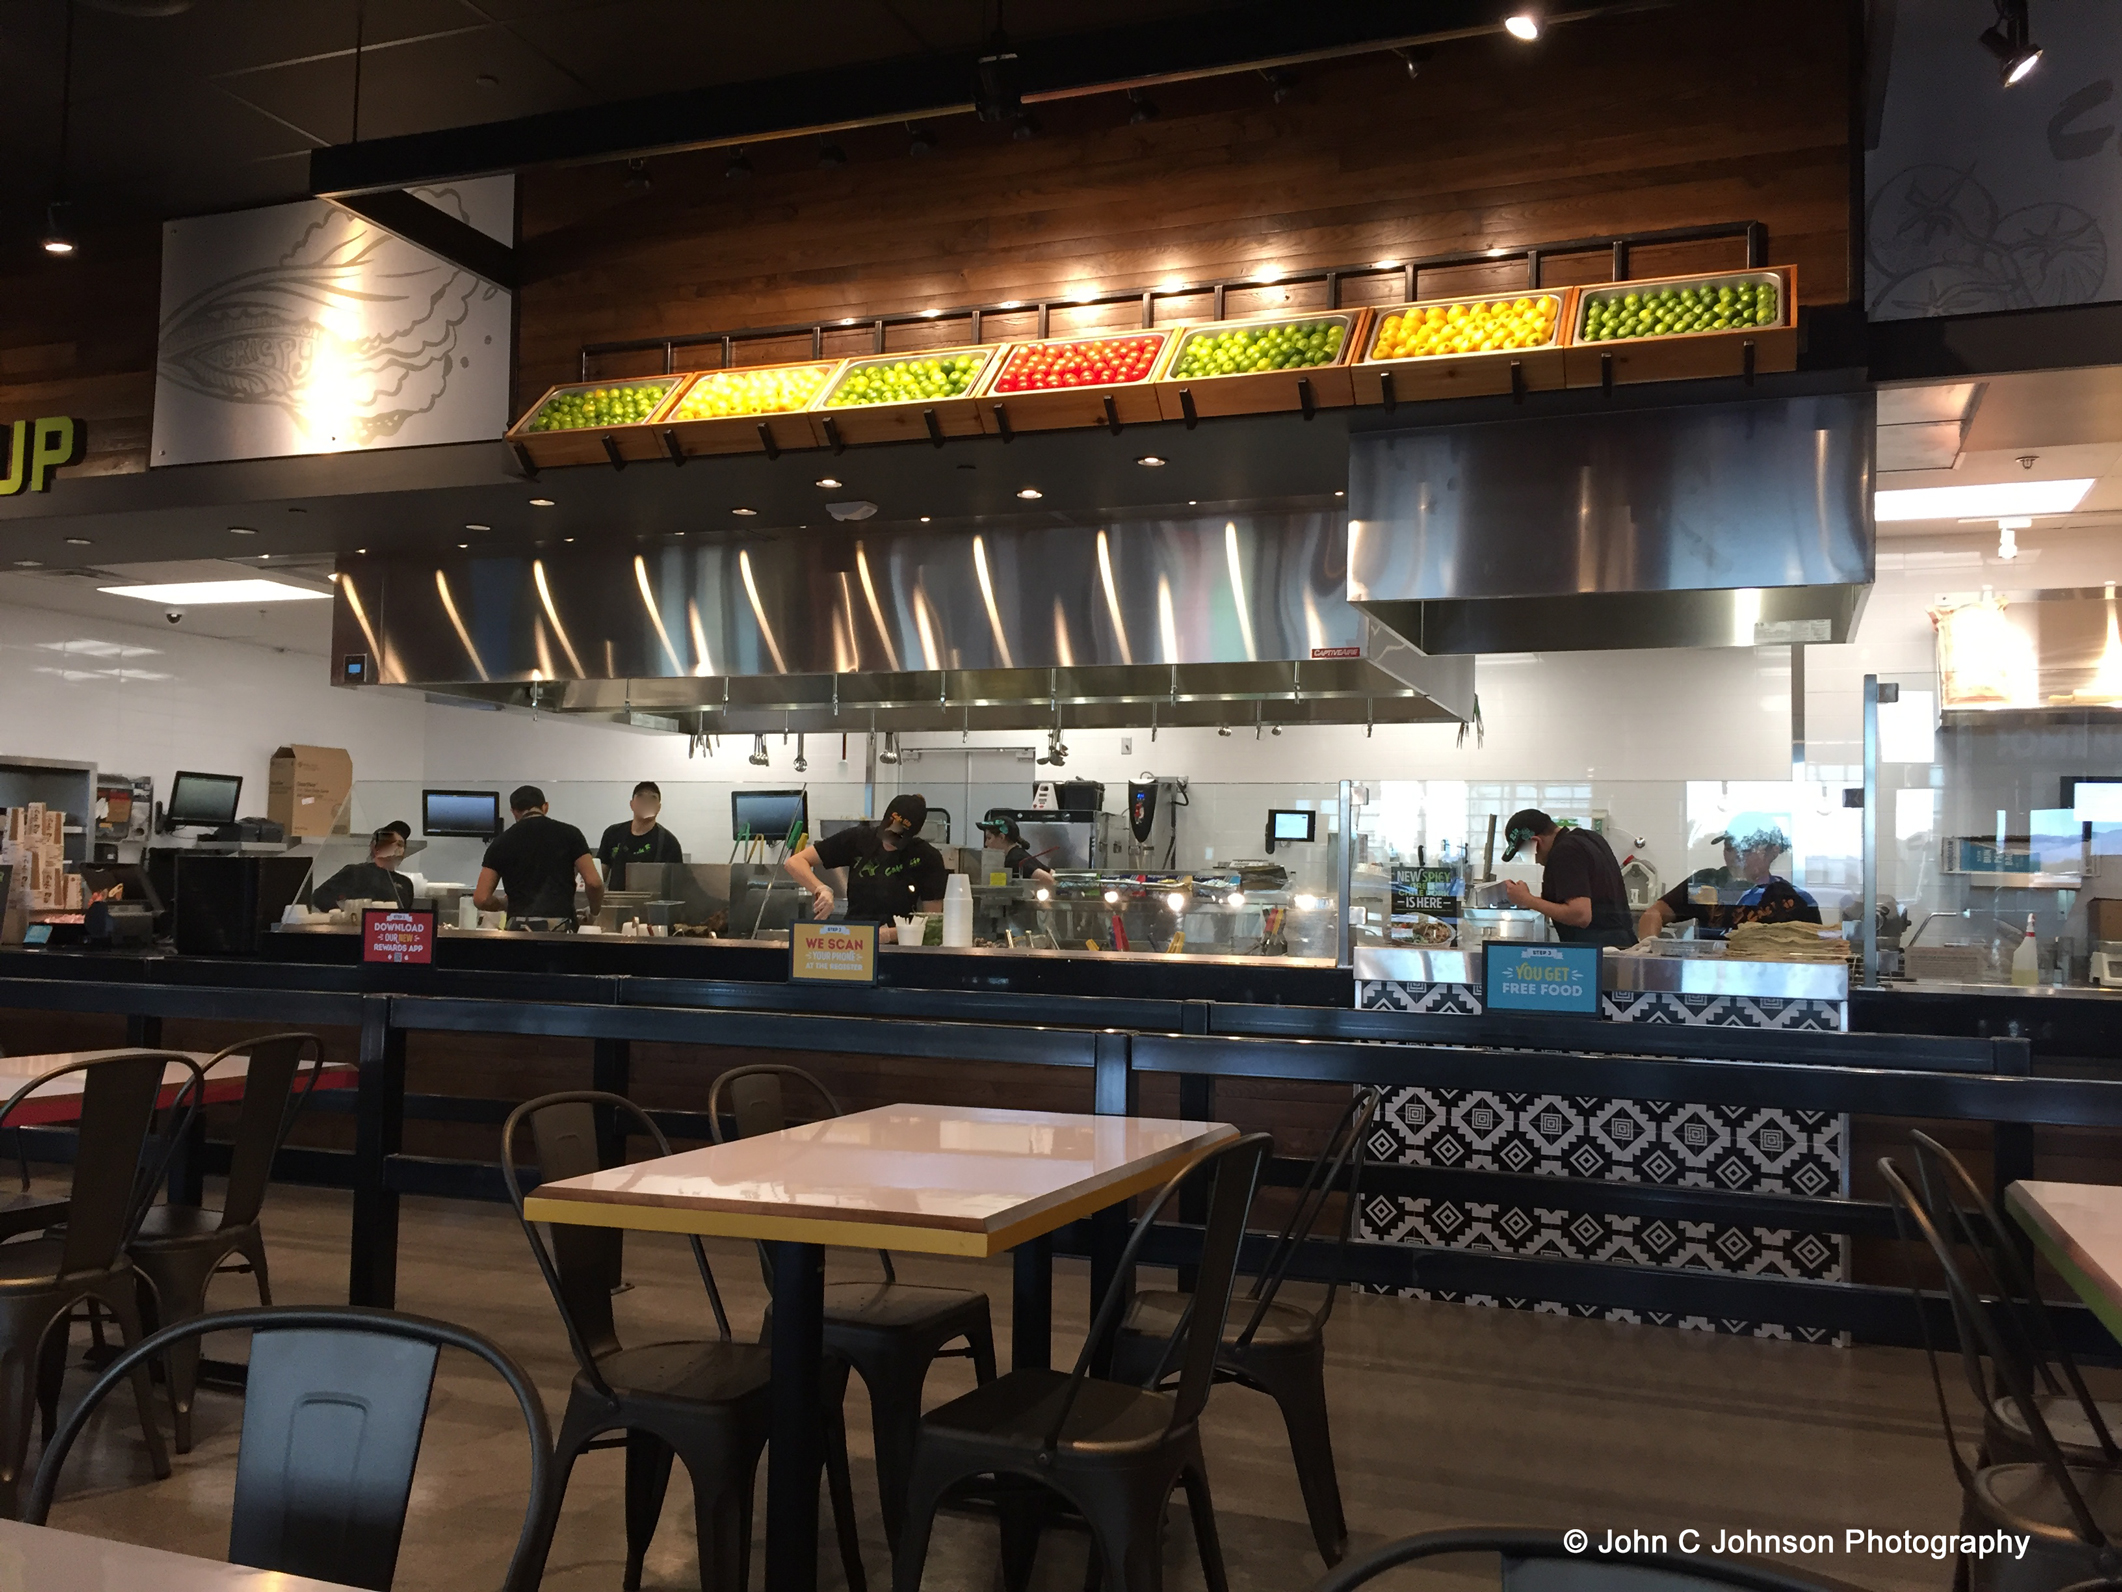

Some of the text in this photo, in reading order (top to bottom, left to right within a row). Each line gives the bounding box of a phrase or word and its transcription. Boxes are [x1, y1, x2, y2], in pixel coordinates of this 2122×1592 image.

[221, 337, 314, 380] CRISPY
[1397, 869, 1451, 884] NEW SPICY
[1406, 896, 1443, 909] IS HERE
[374, 922, 424, 932] DOWNLOAD
[385, 933, 413, 944] OUR NEW
[805, 938, 864, 950] WE SCAN
[374, 943, 424, 952] REWARDS APP
[813, 950, 856, 962] YOUR PHONE
[815, 962, 828, 970] THE
[829, 963, 863, 971] REGISTER
[1515, 962, 1570, 982] YOU GET
[1502, 982, 1583, 997] FREE FOOD
